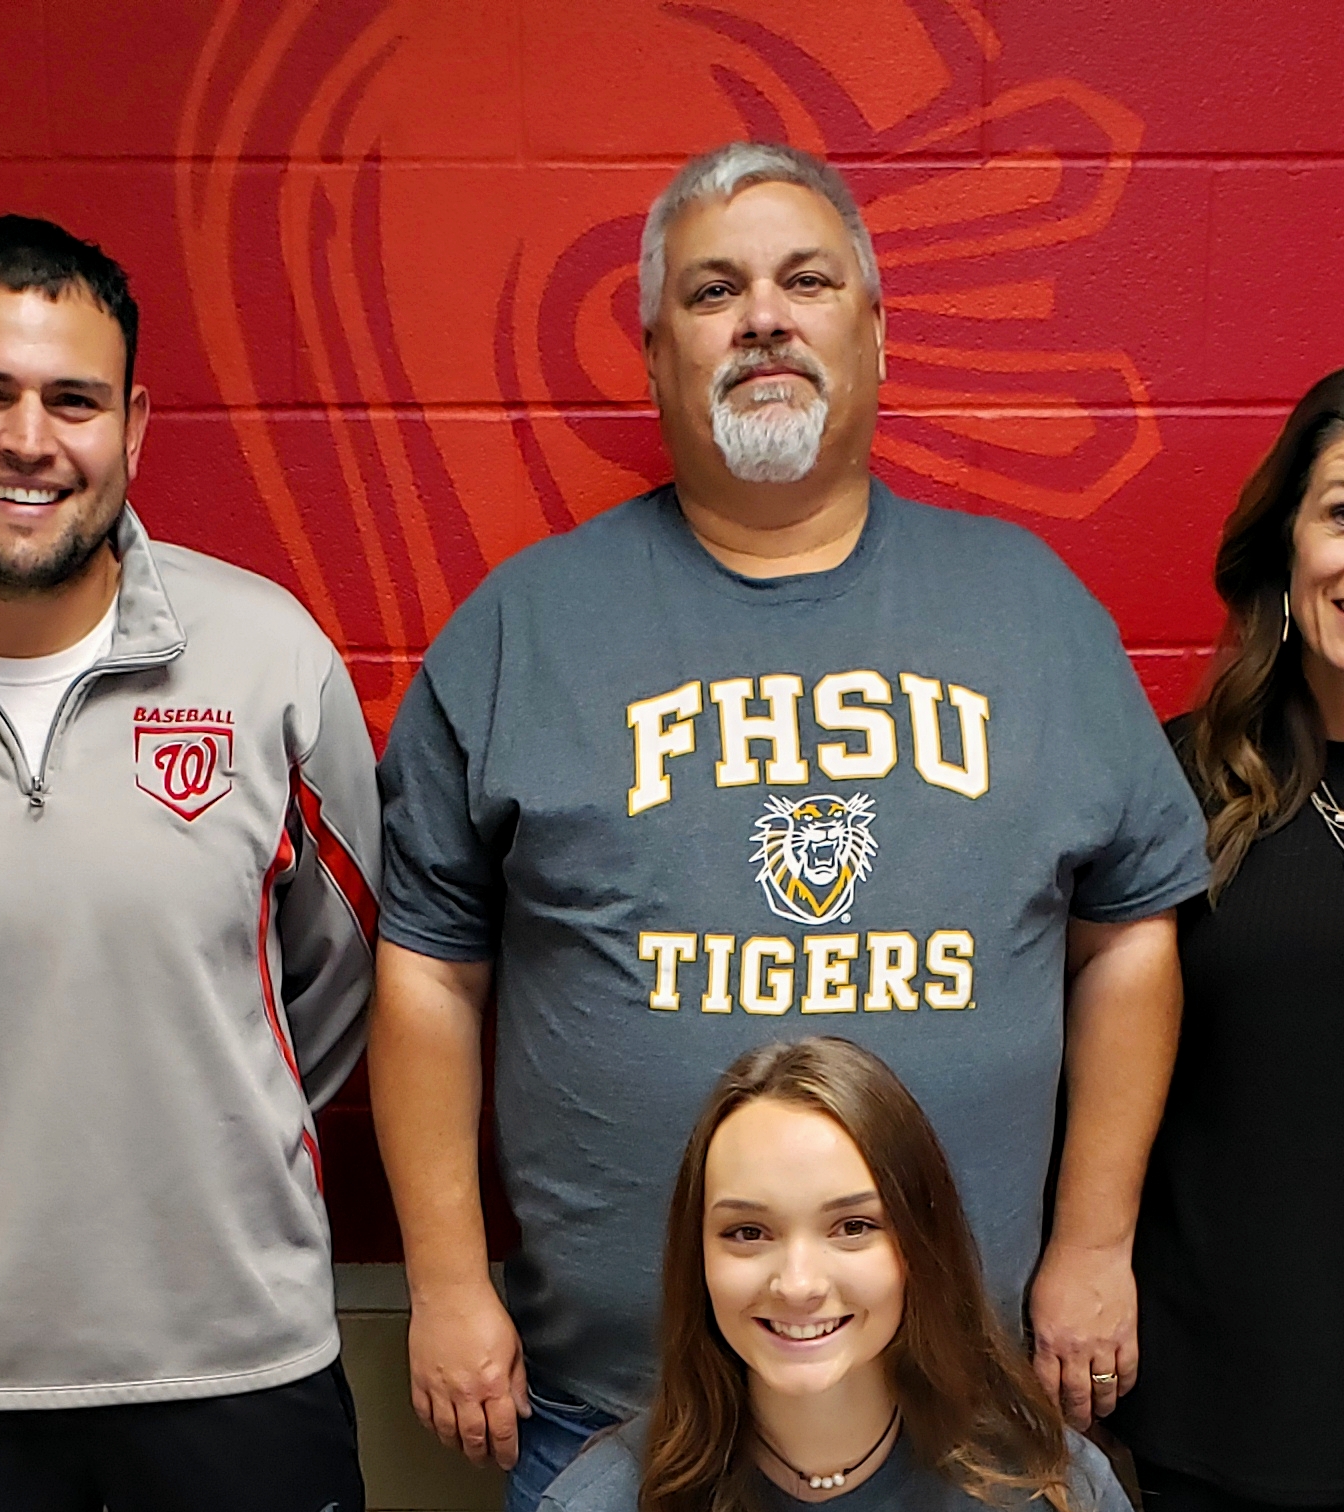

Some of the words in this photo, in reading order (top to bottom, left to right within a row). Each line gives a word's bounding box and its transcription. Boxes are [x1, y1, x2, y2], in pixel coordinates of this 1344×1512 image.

[133, 706, 235, 725] BASEBALL
[627, 668, 990, 817] FHSU
[638, 930, 975, 1016] TIGERS
